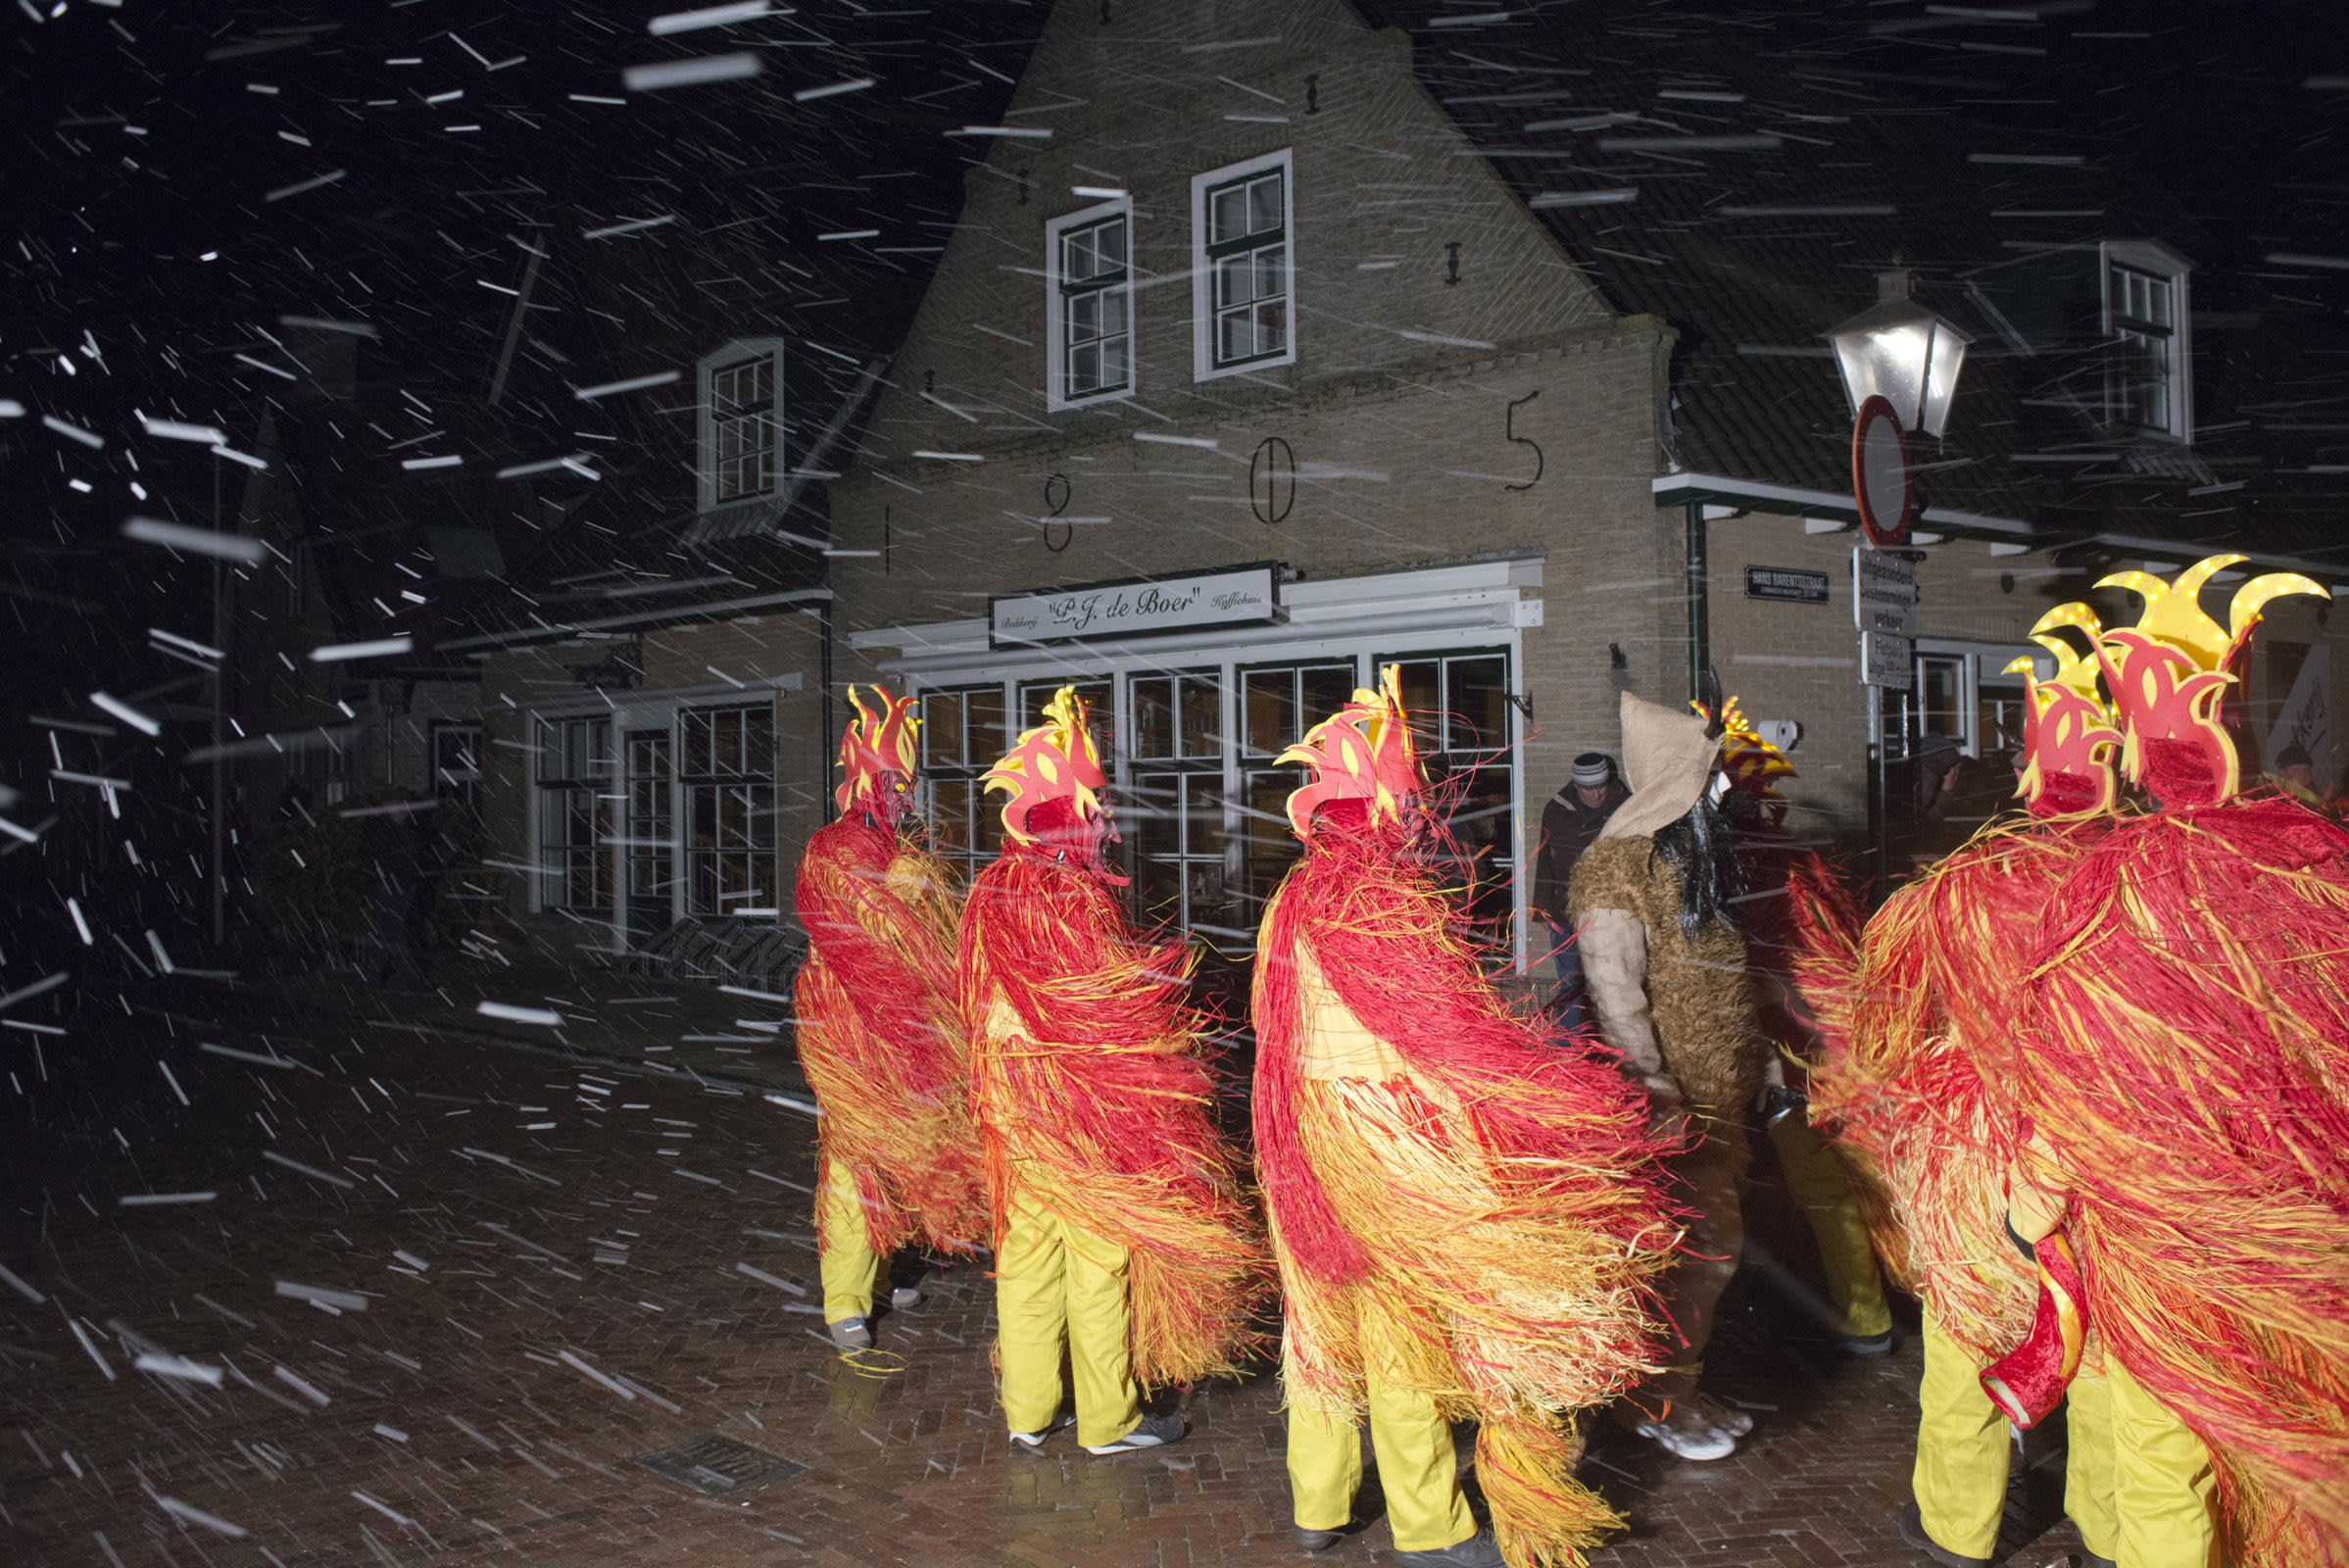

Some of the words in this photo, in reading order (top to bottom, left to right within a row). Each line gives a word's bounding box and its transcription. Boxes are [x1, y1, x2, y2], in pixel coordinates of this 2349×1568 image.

[1002, 616, 1038, 630] Bakkerij
[1106, 592, 1130, 619] de
[1210, 591, 1262, 611] Koffiehuis
